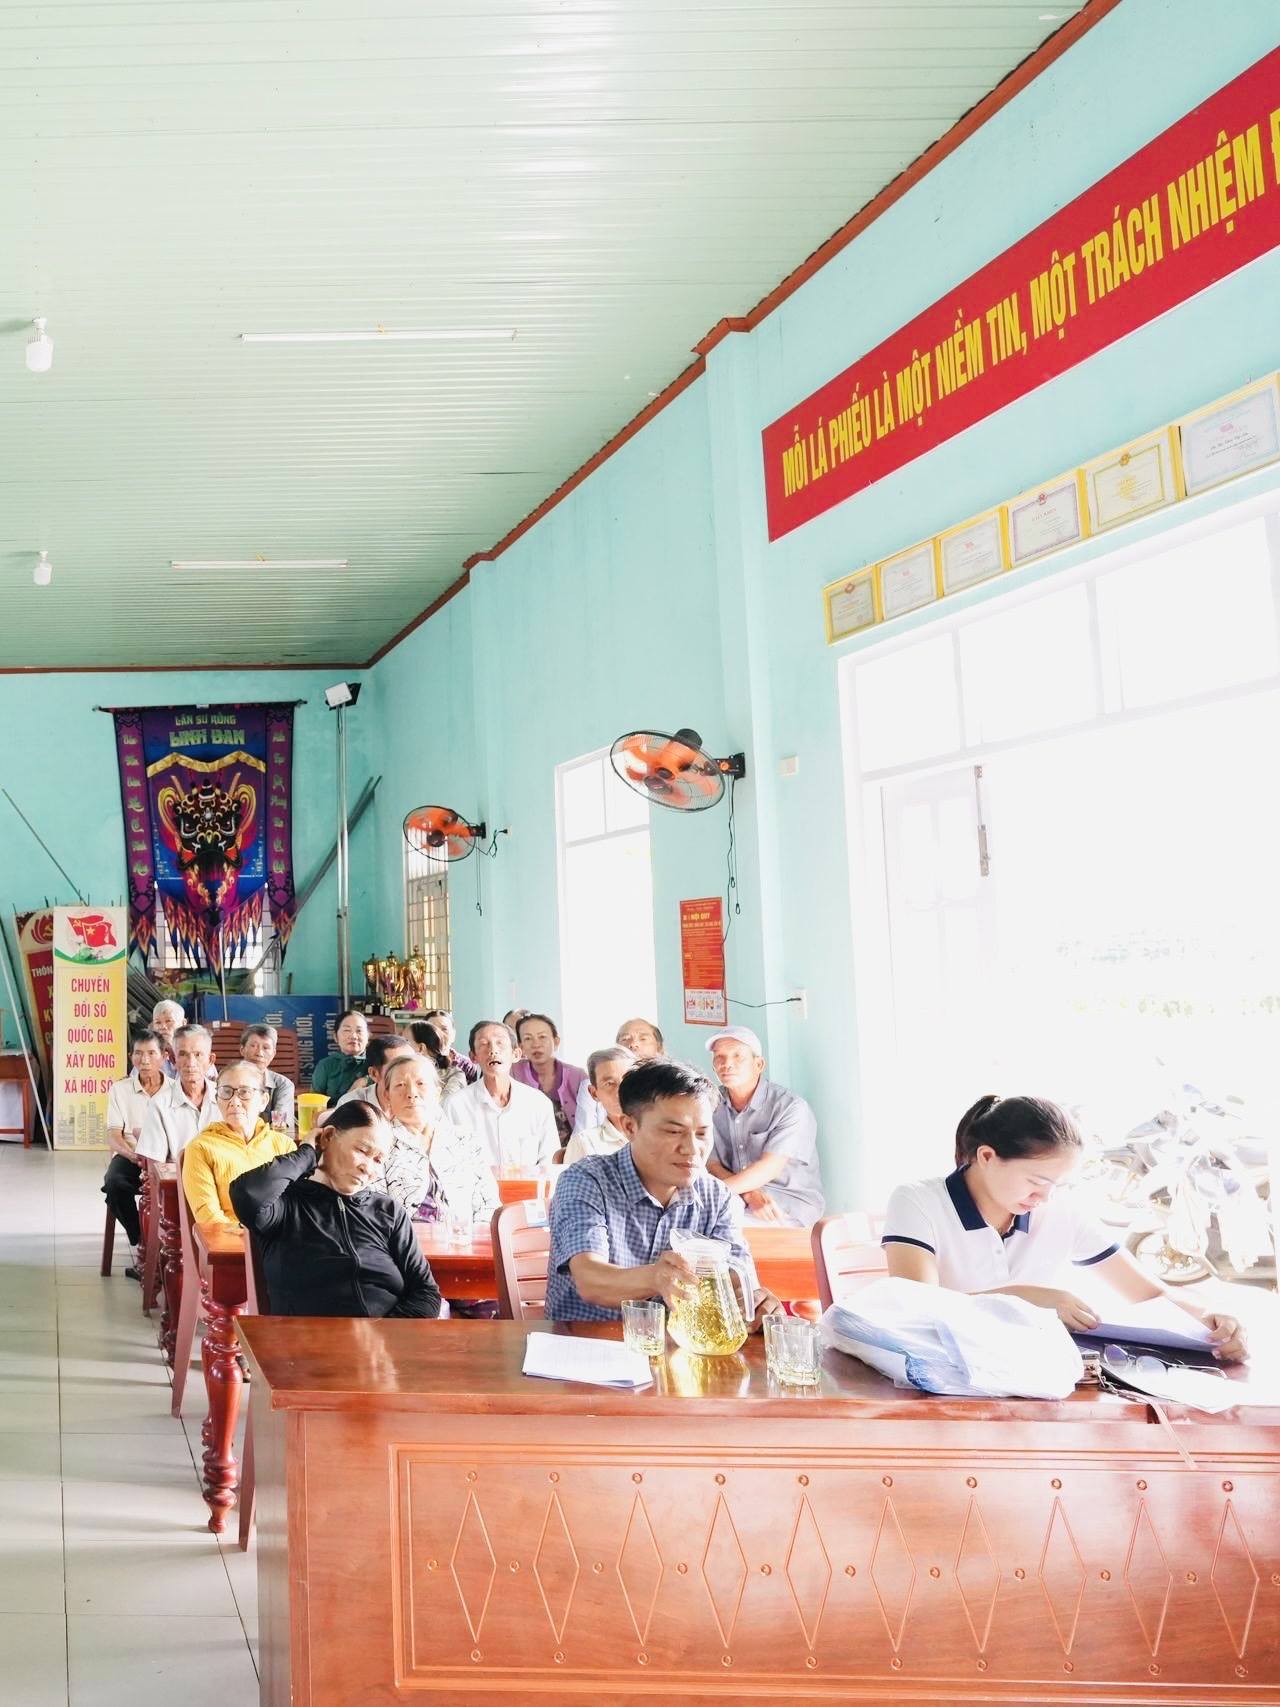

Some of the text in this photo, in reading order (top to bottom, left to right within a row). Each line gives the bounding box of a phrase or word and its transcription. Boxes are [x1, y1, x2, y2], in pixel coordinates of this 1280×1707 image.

[783, 424, 809, 498] MỖI
[810, 417, 828, 481] LÁ
[829, 382, 872, 469] PHIẾU
[873, 370, 895, 441] LÀ
[896, 349, 932, 426] MỘT
[935, 308, 985, 400] NIỀM
[986, 292, 1028, 367] TIN,
[1030, 249, 1077, 341] MỘT
[1081, 193, 1164, 305] TRÁCH
[1167, 123, 1265, 251] NHIỆM
[71, 973, 110, 993] CHUYỂN
[94, 999, 107, 1018] SỐ
[67, 1023, 94, 1044] QUỐC
[97, 1029, 114, 1043] GIA
[66, 1051, 115, 1071] XÂY DỰNG
[81, 1076, 97, 1096] HỘI
